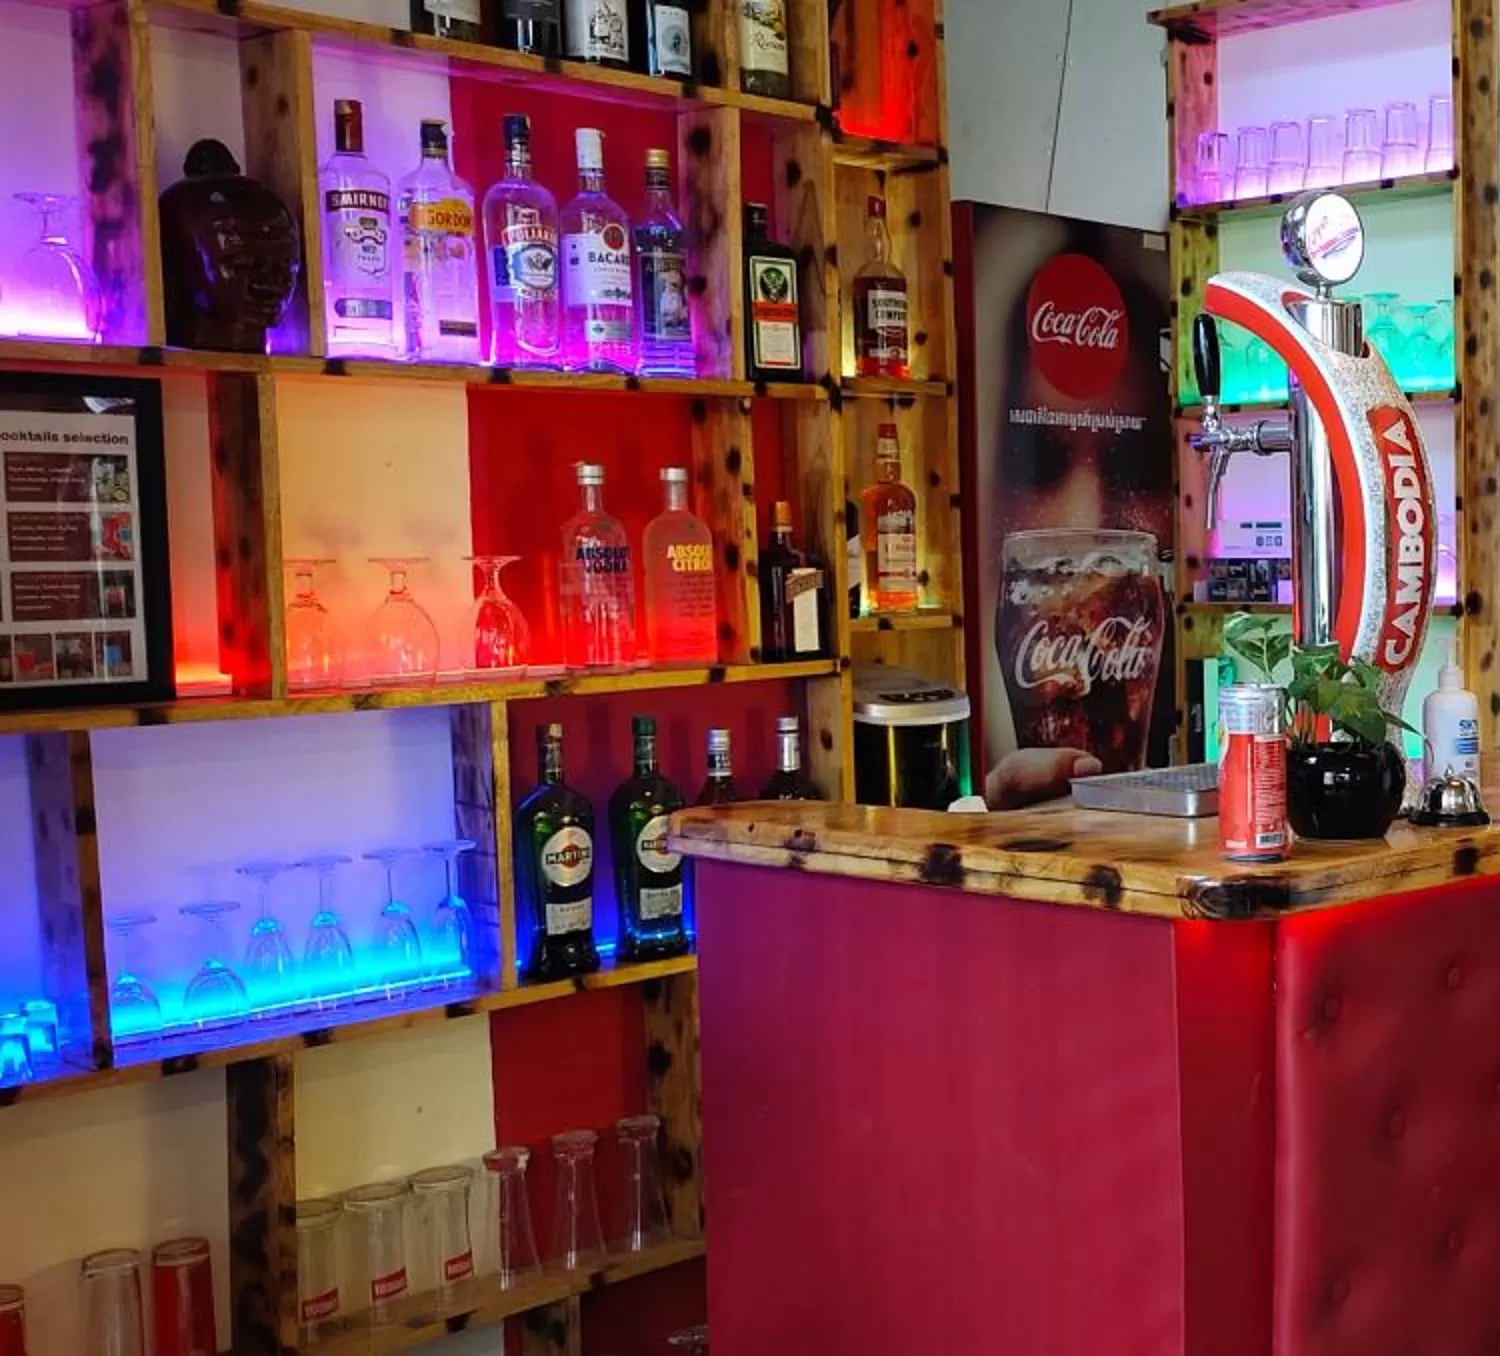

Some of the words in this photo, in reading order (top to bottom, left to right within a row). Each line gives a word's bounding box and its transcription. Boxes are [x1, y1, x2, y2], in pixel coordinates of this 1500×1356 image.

[1031, 301, 1125, 350] Coca-Cola
[0, 431, 59, 444] ocktails
[63, 432, 129, 445] selection
[1384, 420, 1424, 665] CAMBODIA
[1015, 616, 1152, 695] Coca-Cola
